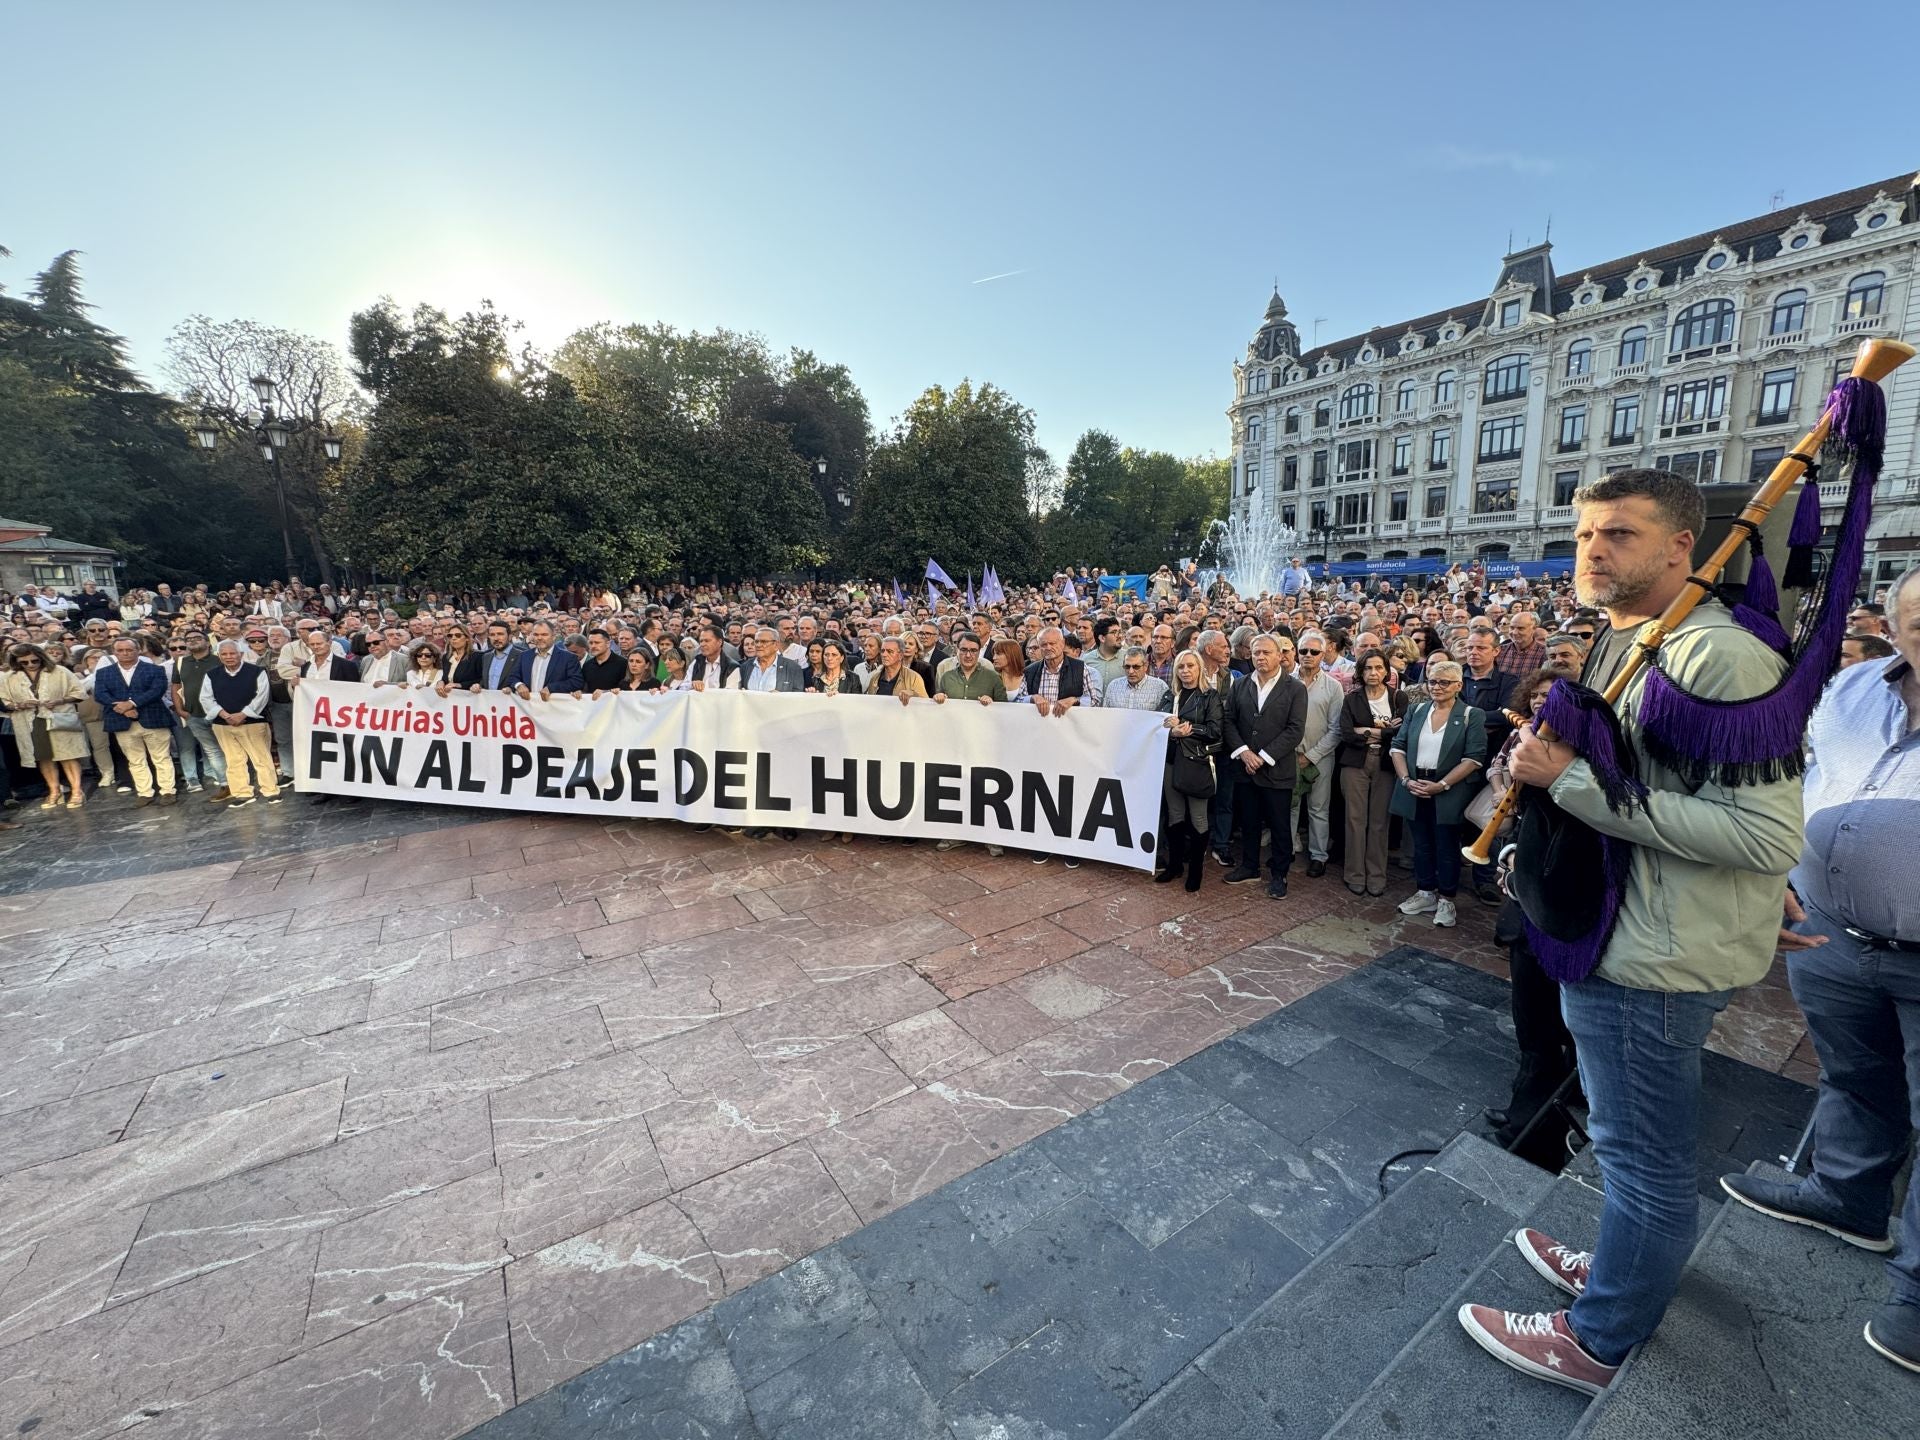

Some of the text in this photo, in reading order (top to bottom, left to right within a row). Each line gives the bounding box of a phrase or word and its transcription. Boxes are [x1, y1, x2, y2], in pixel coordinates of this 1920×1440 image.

[313, 697, 536, 740] Asturias Unida
[309, 730, 1156, 854] FIN AL PEAJE DEL HUERNA.
